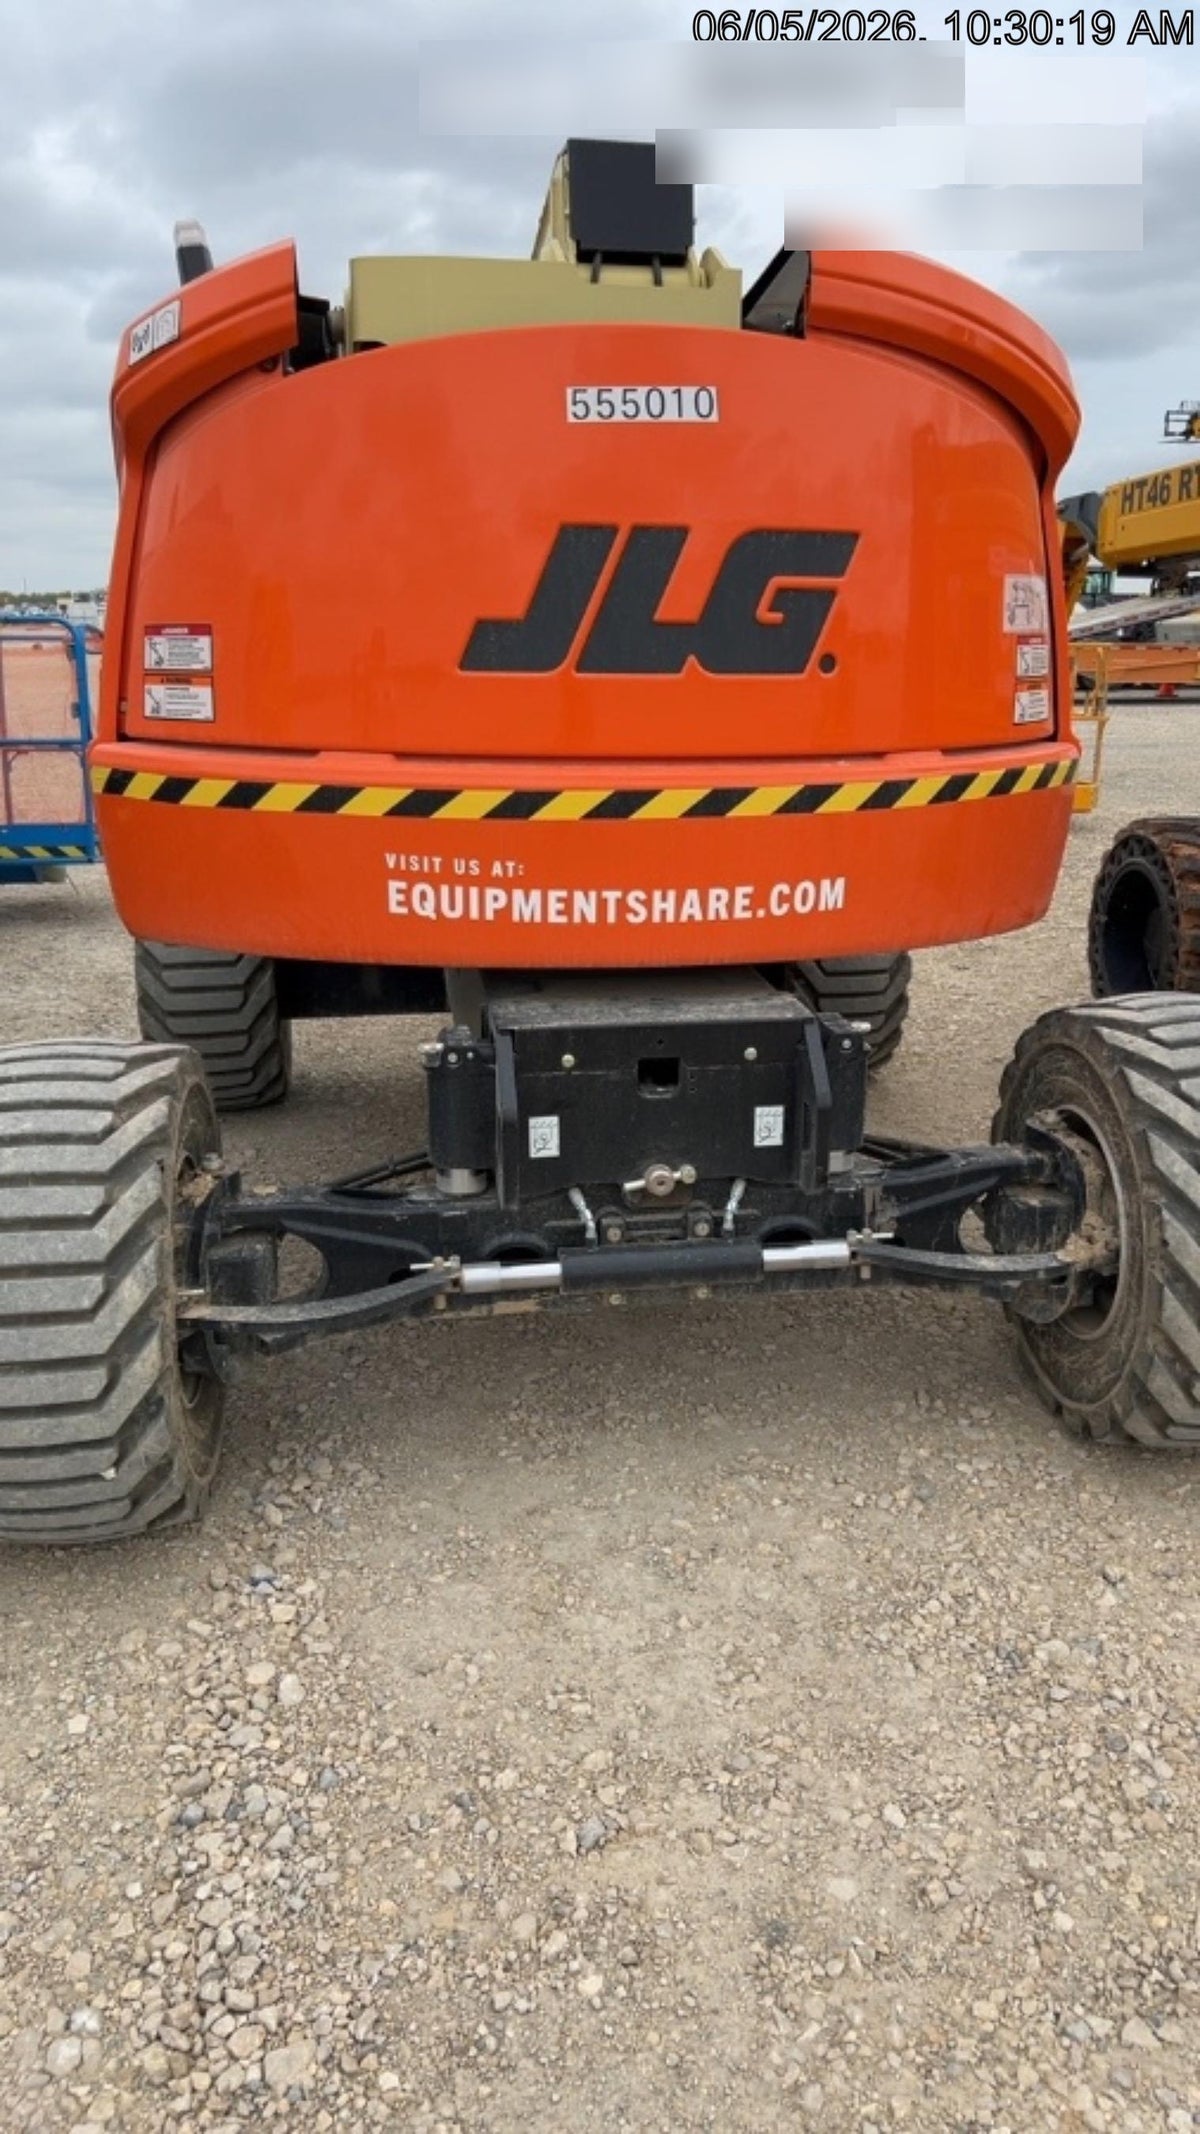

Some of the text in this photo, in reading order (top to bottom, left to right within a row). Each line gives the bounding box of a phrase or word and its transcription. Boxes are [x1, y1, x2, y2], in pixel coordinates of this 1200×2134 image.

[571, 388, 715, 419] 555010
[1121, 473, 1171, 515] HT46
[384, 852, 525, 878] VISIT US AT:
[386, 876, 846, 924] EQUIPMENTSHARE.COM
